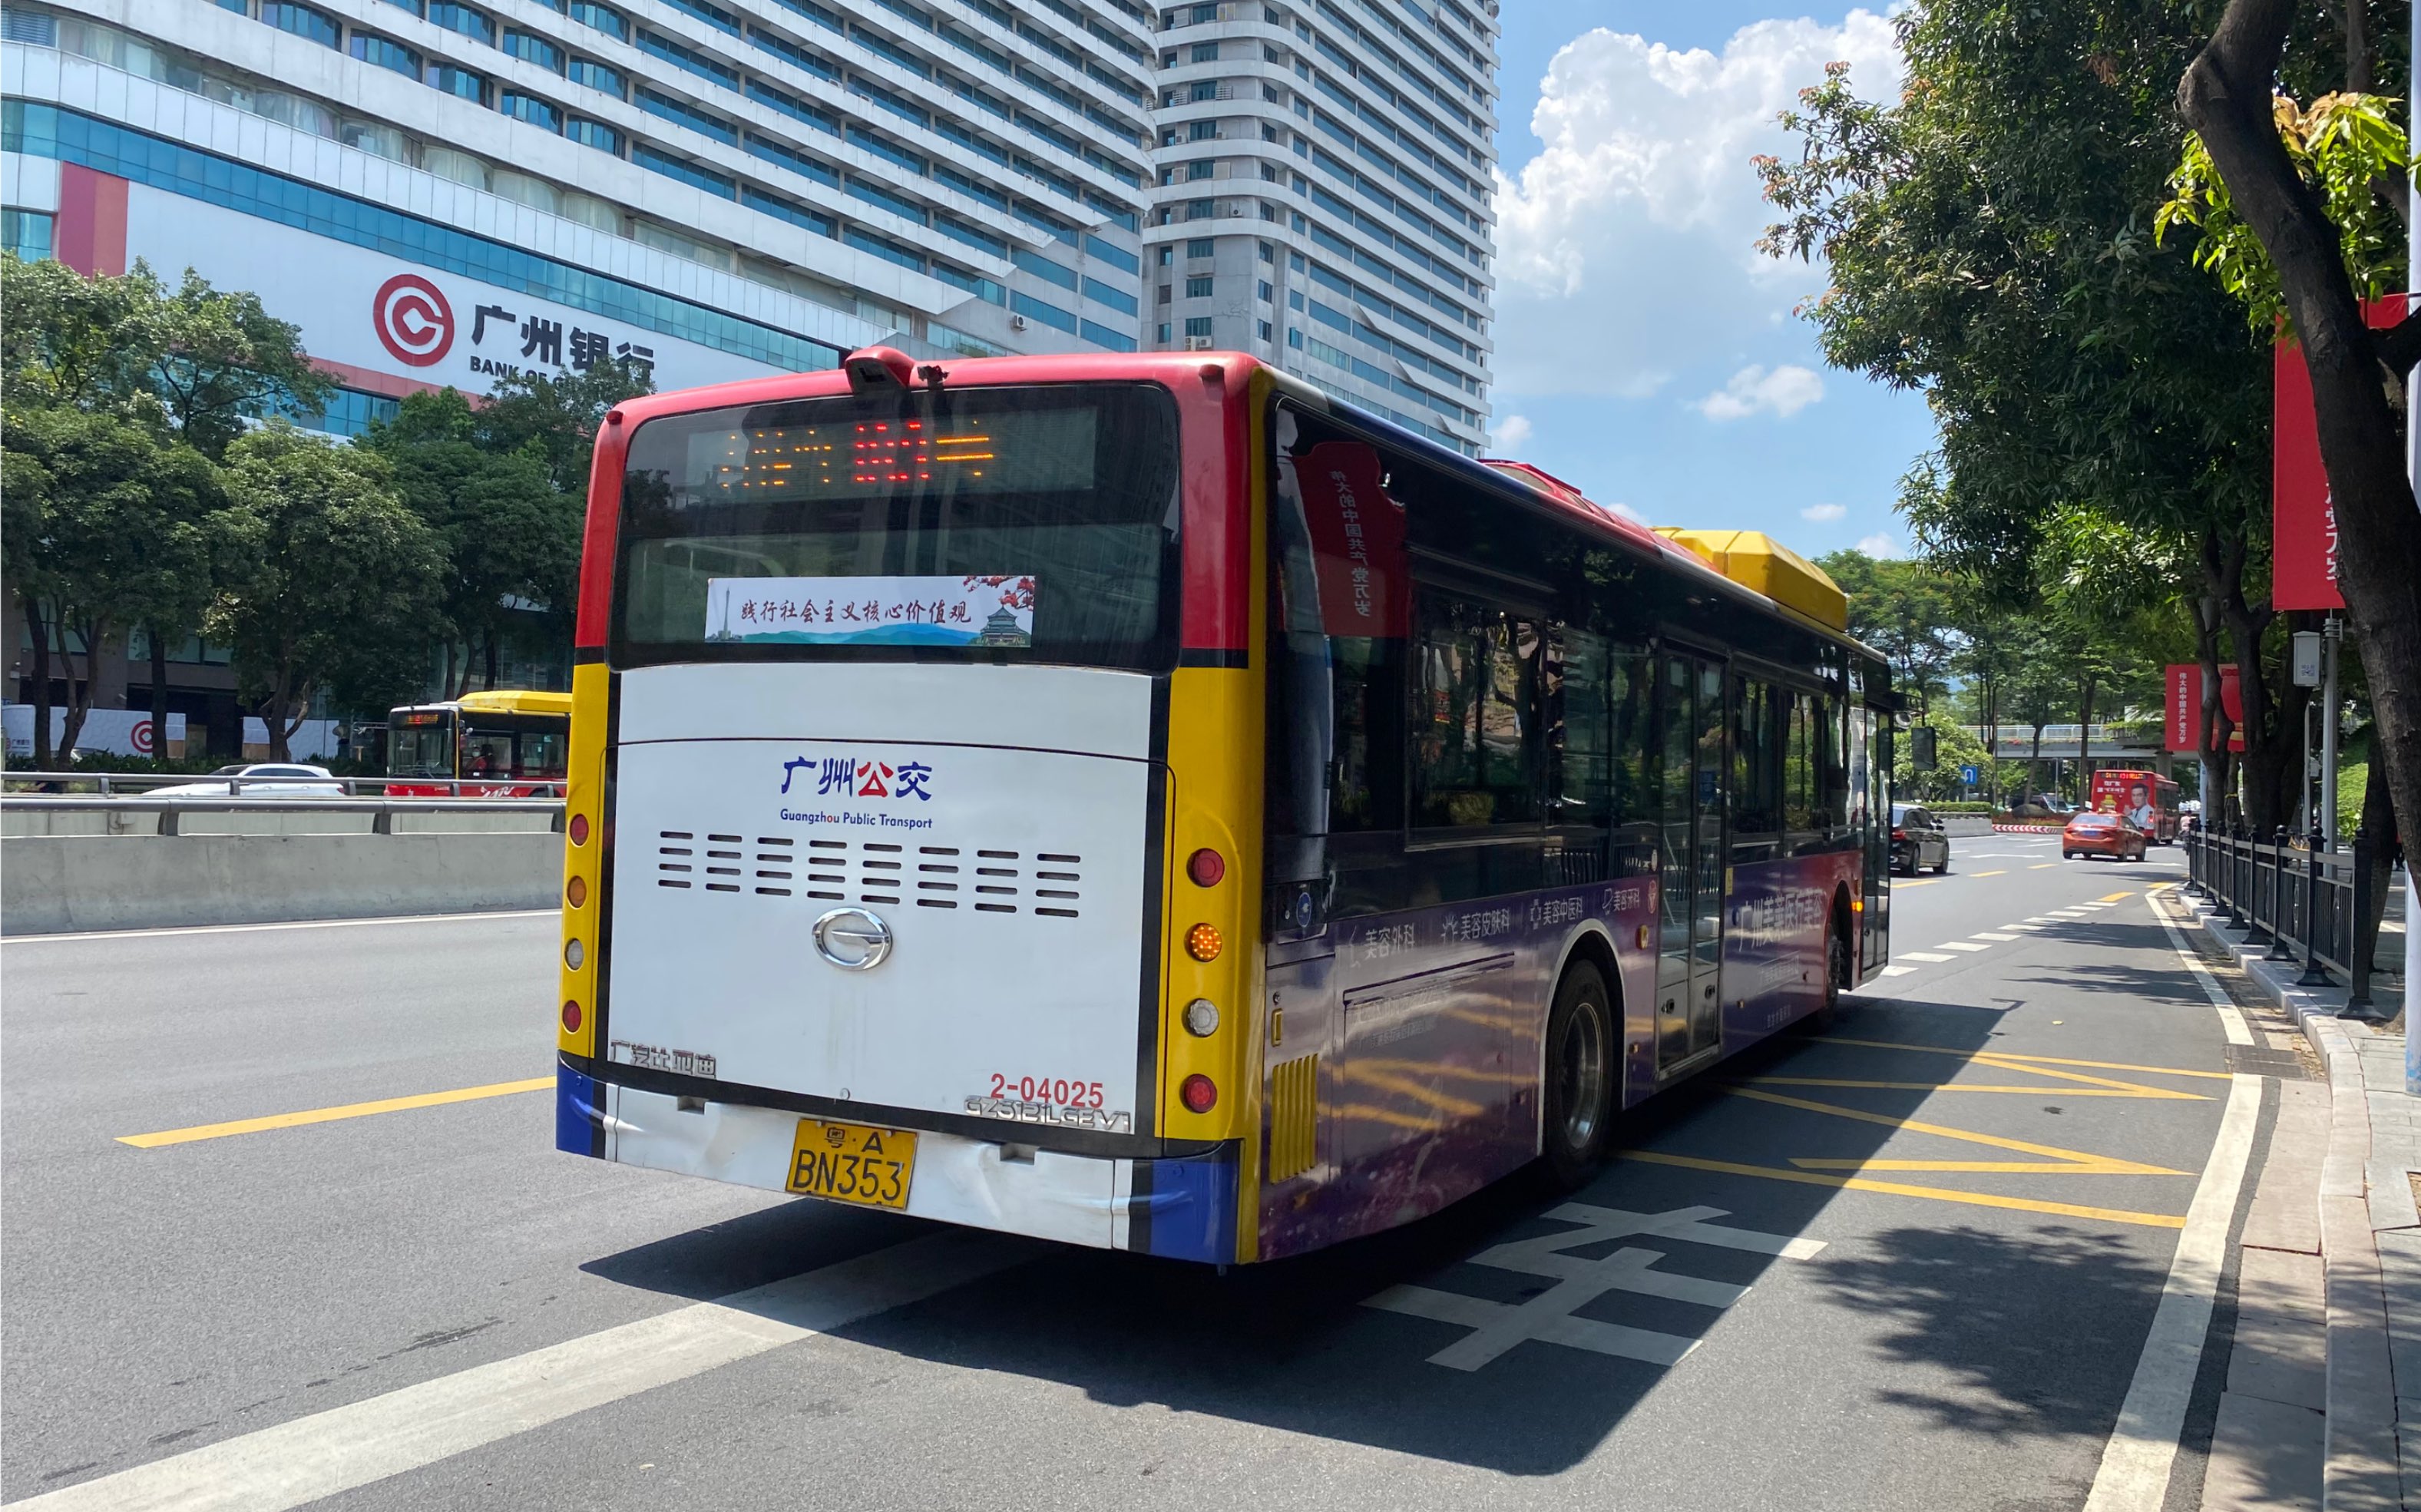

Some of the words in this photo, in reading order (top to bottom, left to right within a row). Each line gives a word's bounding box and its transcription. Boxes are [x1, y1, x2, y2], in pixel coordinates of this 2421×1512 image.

[471, 304, 655, 386] 广州银行
[470, 356, 520, 379] BANK
[740, 598, 972, 625] 践行社会主义核心价值观
[780, 756, 933, 802] 广州公交
[780, 809, 840, 825] Guangzhou
[843, 812, 876, 826] Public
[879, 813, 933, 831] Transport
[1460, 908, 1511, 942] 美容皮肤科
[1543, 895, 1584, 926] 美容中医科
[1364, 922, 1416, 961] 美容外科
[610, 1039, 716, 1080] 广汽比亚迪
[990, 1073, 1104, 1109] 2-04025
[792, 1148, 905, 1201] BN353
[1356, 1202, 1829, 1372] 车
